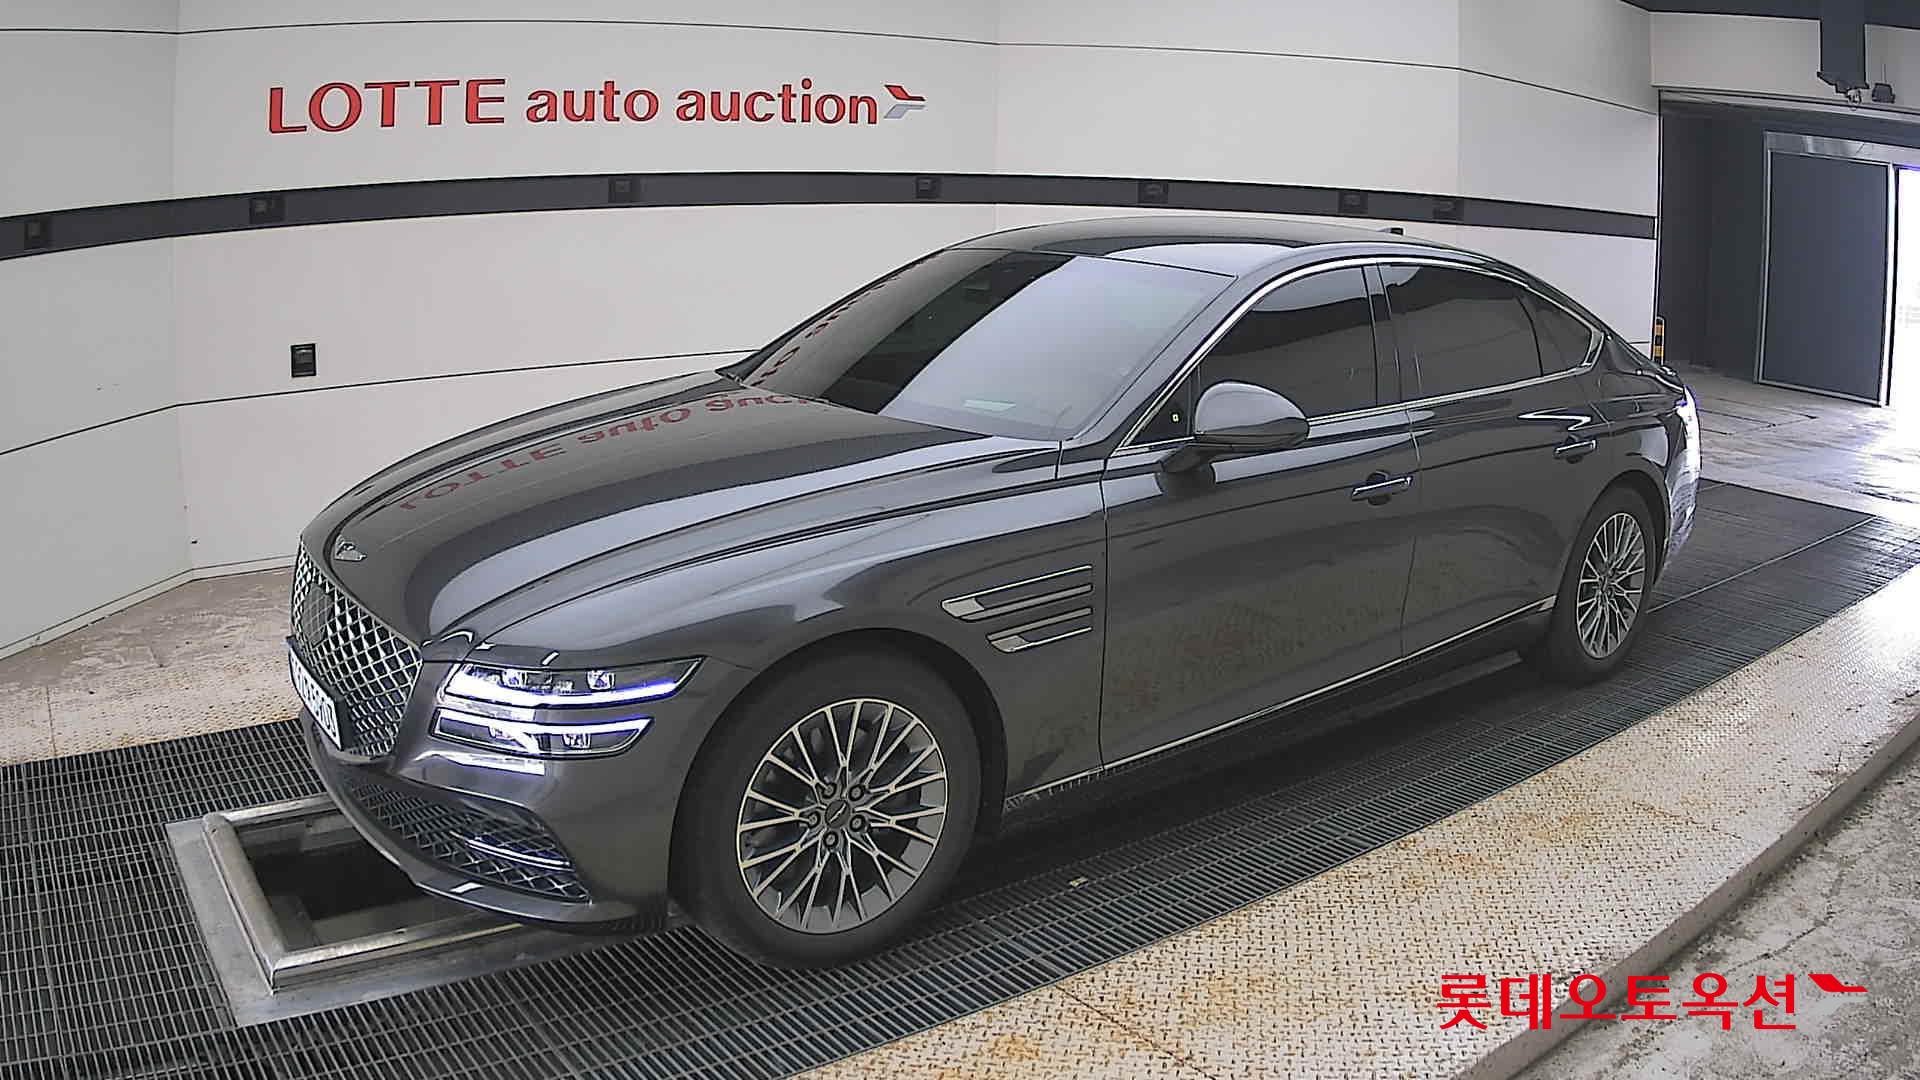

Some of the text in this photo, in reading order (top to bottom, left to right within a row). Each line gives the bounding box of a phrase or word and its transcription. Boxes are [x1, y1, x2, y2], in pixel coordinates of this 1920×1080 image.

[267, 78, 879, 135] LOTTE auto auction
